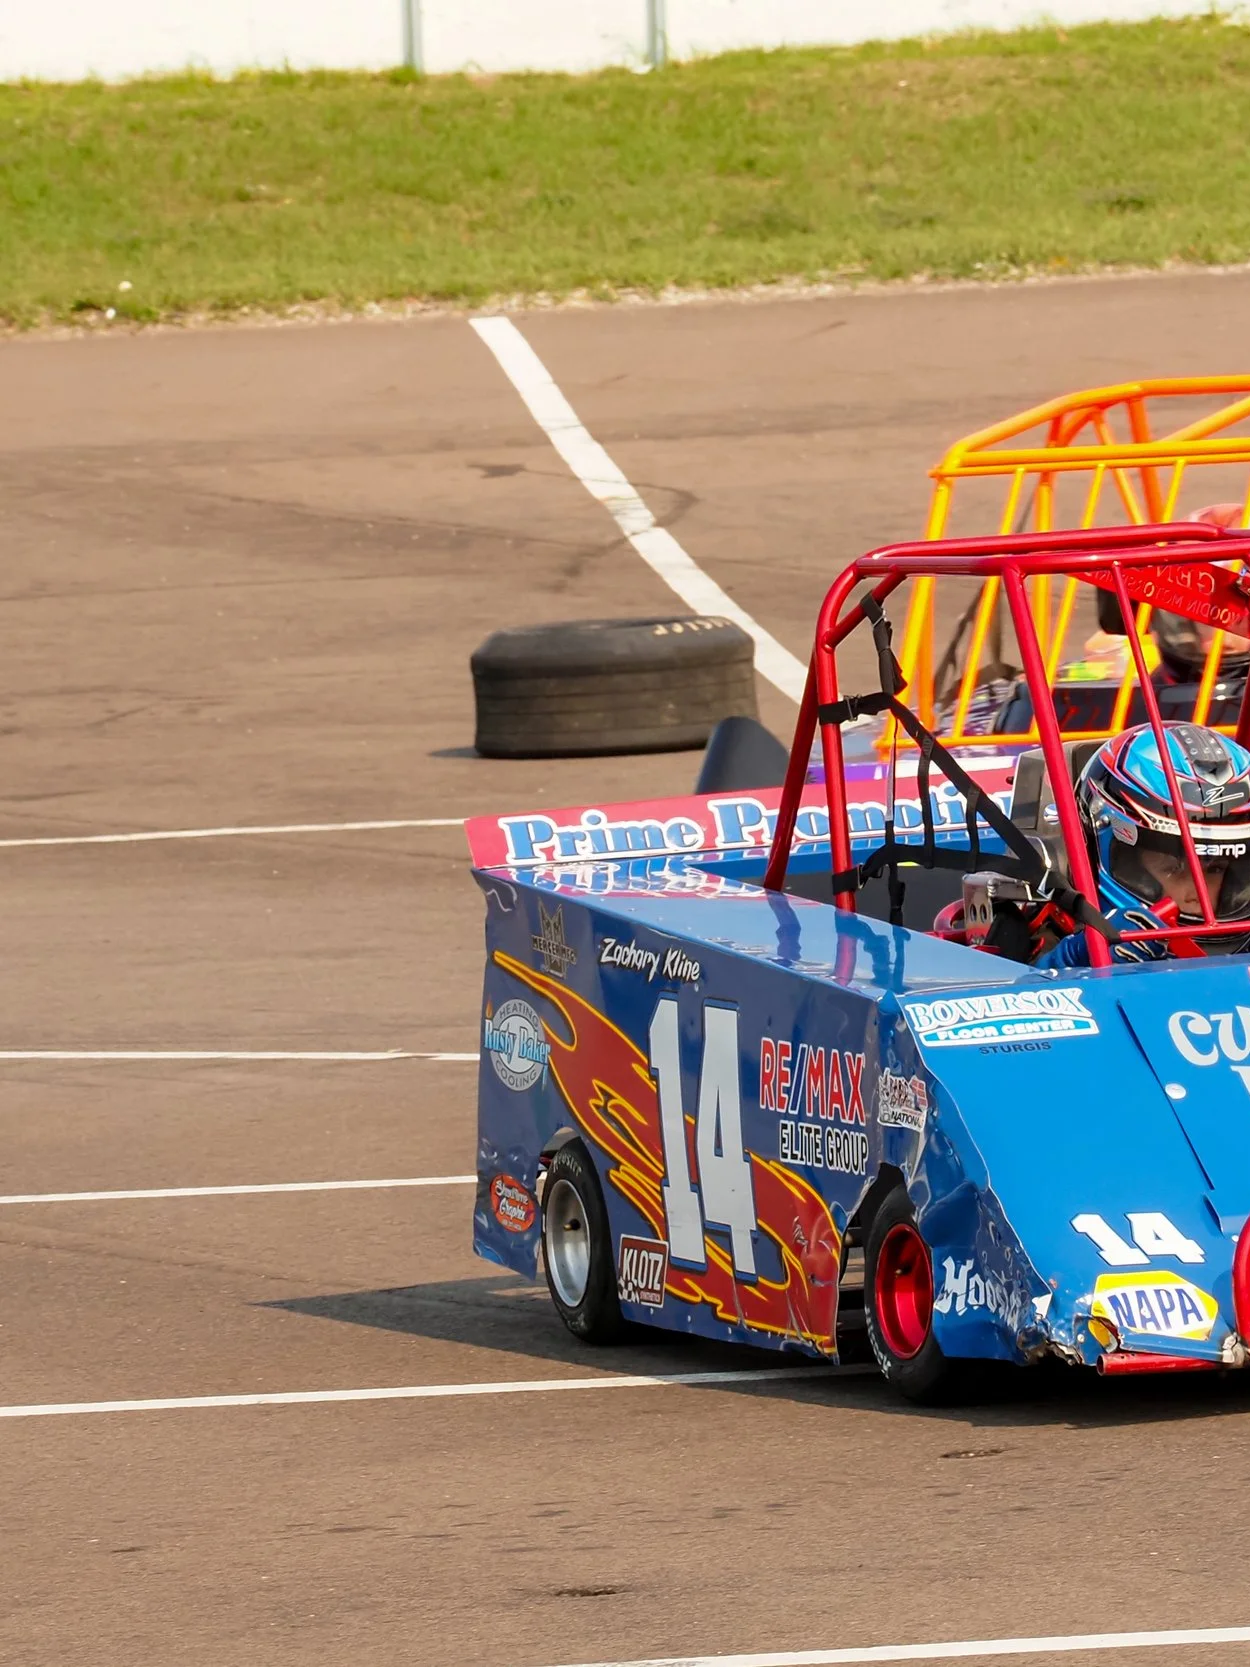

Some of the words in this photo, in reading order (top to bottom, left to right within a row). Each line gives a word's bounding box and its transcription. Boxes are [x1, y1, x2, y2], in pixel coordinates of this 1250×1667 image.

[500, 811, 702, 862] Prime
[1194, 844, 1246, 858] zamp
[600, 937, 660, 982] Zachary
[663, 946, 700, 981] Kline
[499, 1003, 539, 1028] HEATING
[905, 988, 1092, 1031] BOWERSOX
[936, 1026, 999, 1041] FLOOR
[1001, 1019, 1076, 1035] CENTER
[484, 1019, 517, 1065] Rusty
[519, 1026, 551, 1066] Baker
[978, 1041, 1052, 1055] STURGIS
[495, 1059, 538, 1087] COOLING
[760, 1037, 867, 1126] RE/MAX
[649, 995, 757, 1280] 14
[780, 1120, 823, 1167] ELITE
[825, 1126, 868, 1175] GROUP
[1069, 1212, 1206, 1266] 14
[622, 1247, 664, 1291] KLOTZ
[1107, 1288, 1203, 1331] NAPA
